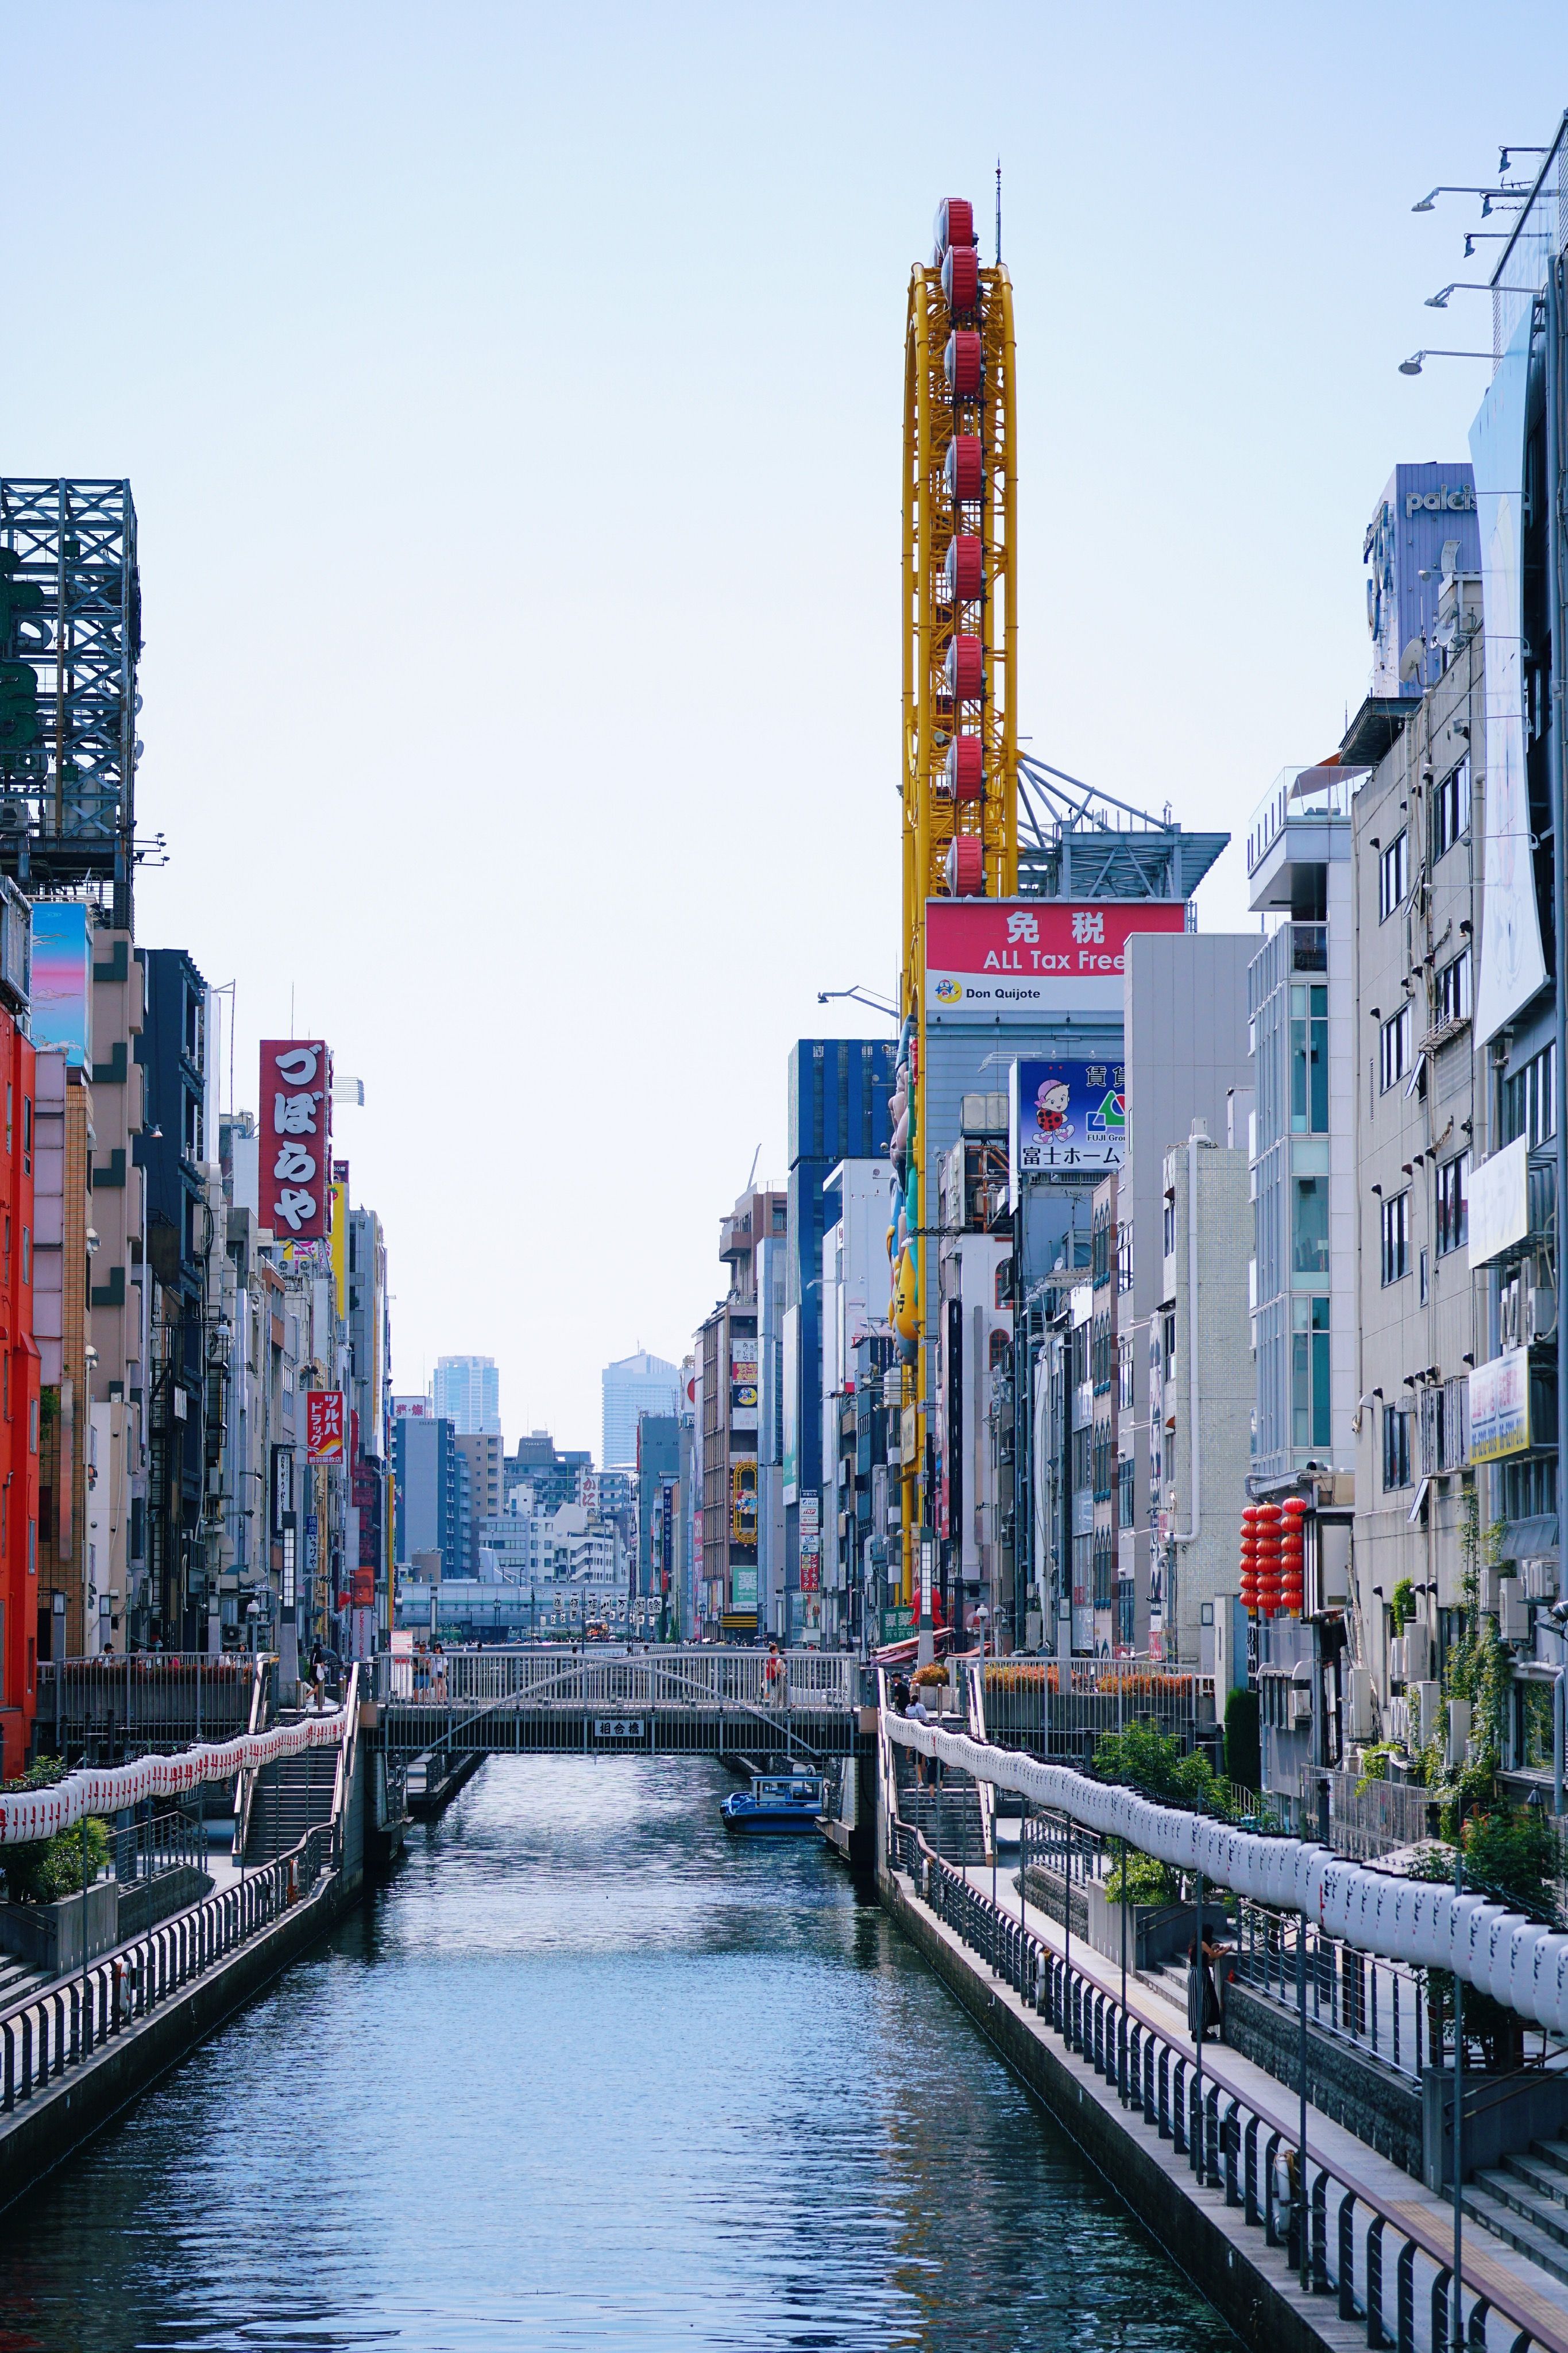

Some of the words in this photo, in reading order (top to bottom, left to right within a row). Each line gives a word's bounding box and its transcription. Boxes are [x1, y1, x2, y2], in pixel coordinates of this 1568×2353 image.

[1007, 912, 1104, 944] 免税
[983, 950, 1022, 969] ALL
[1030, 950, 1071, 969] Tax
[1079, 951, 1125, 970] Free
[966, 989, 990, 998] Don
[995, 989, 1040, 1001] Quijote
[275, 1044, 324, 1230] づぼらや
[1023, 1146, 1125, 1166] 富士ホーム
[311, 1402, 323, 1446] ドラッグ
[325, 1395, 339, 1435] ツルハ
[582, 1477, 596, 1507] かに
[308, 1517, 317, 1533] 焼肉
[738, 1571, 757, 1591] 薬
[600, 1722, 639, 1735] 相合橋
